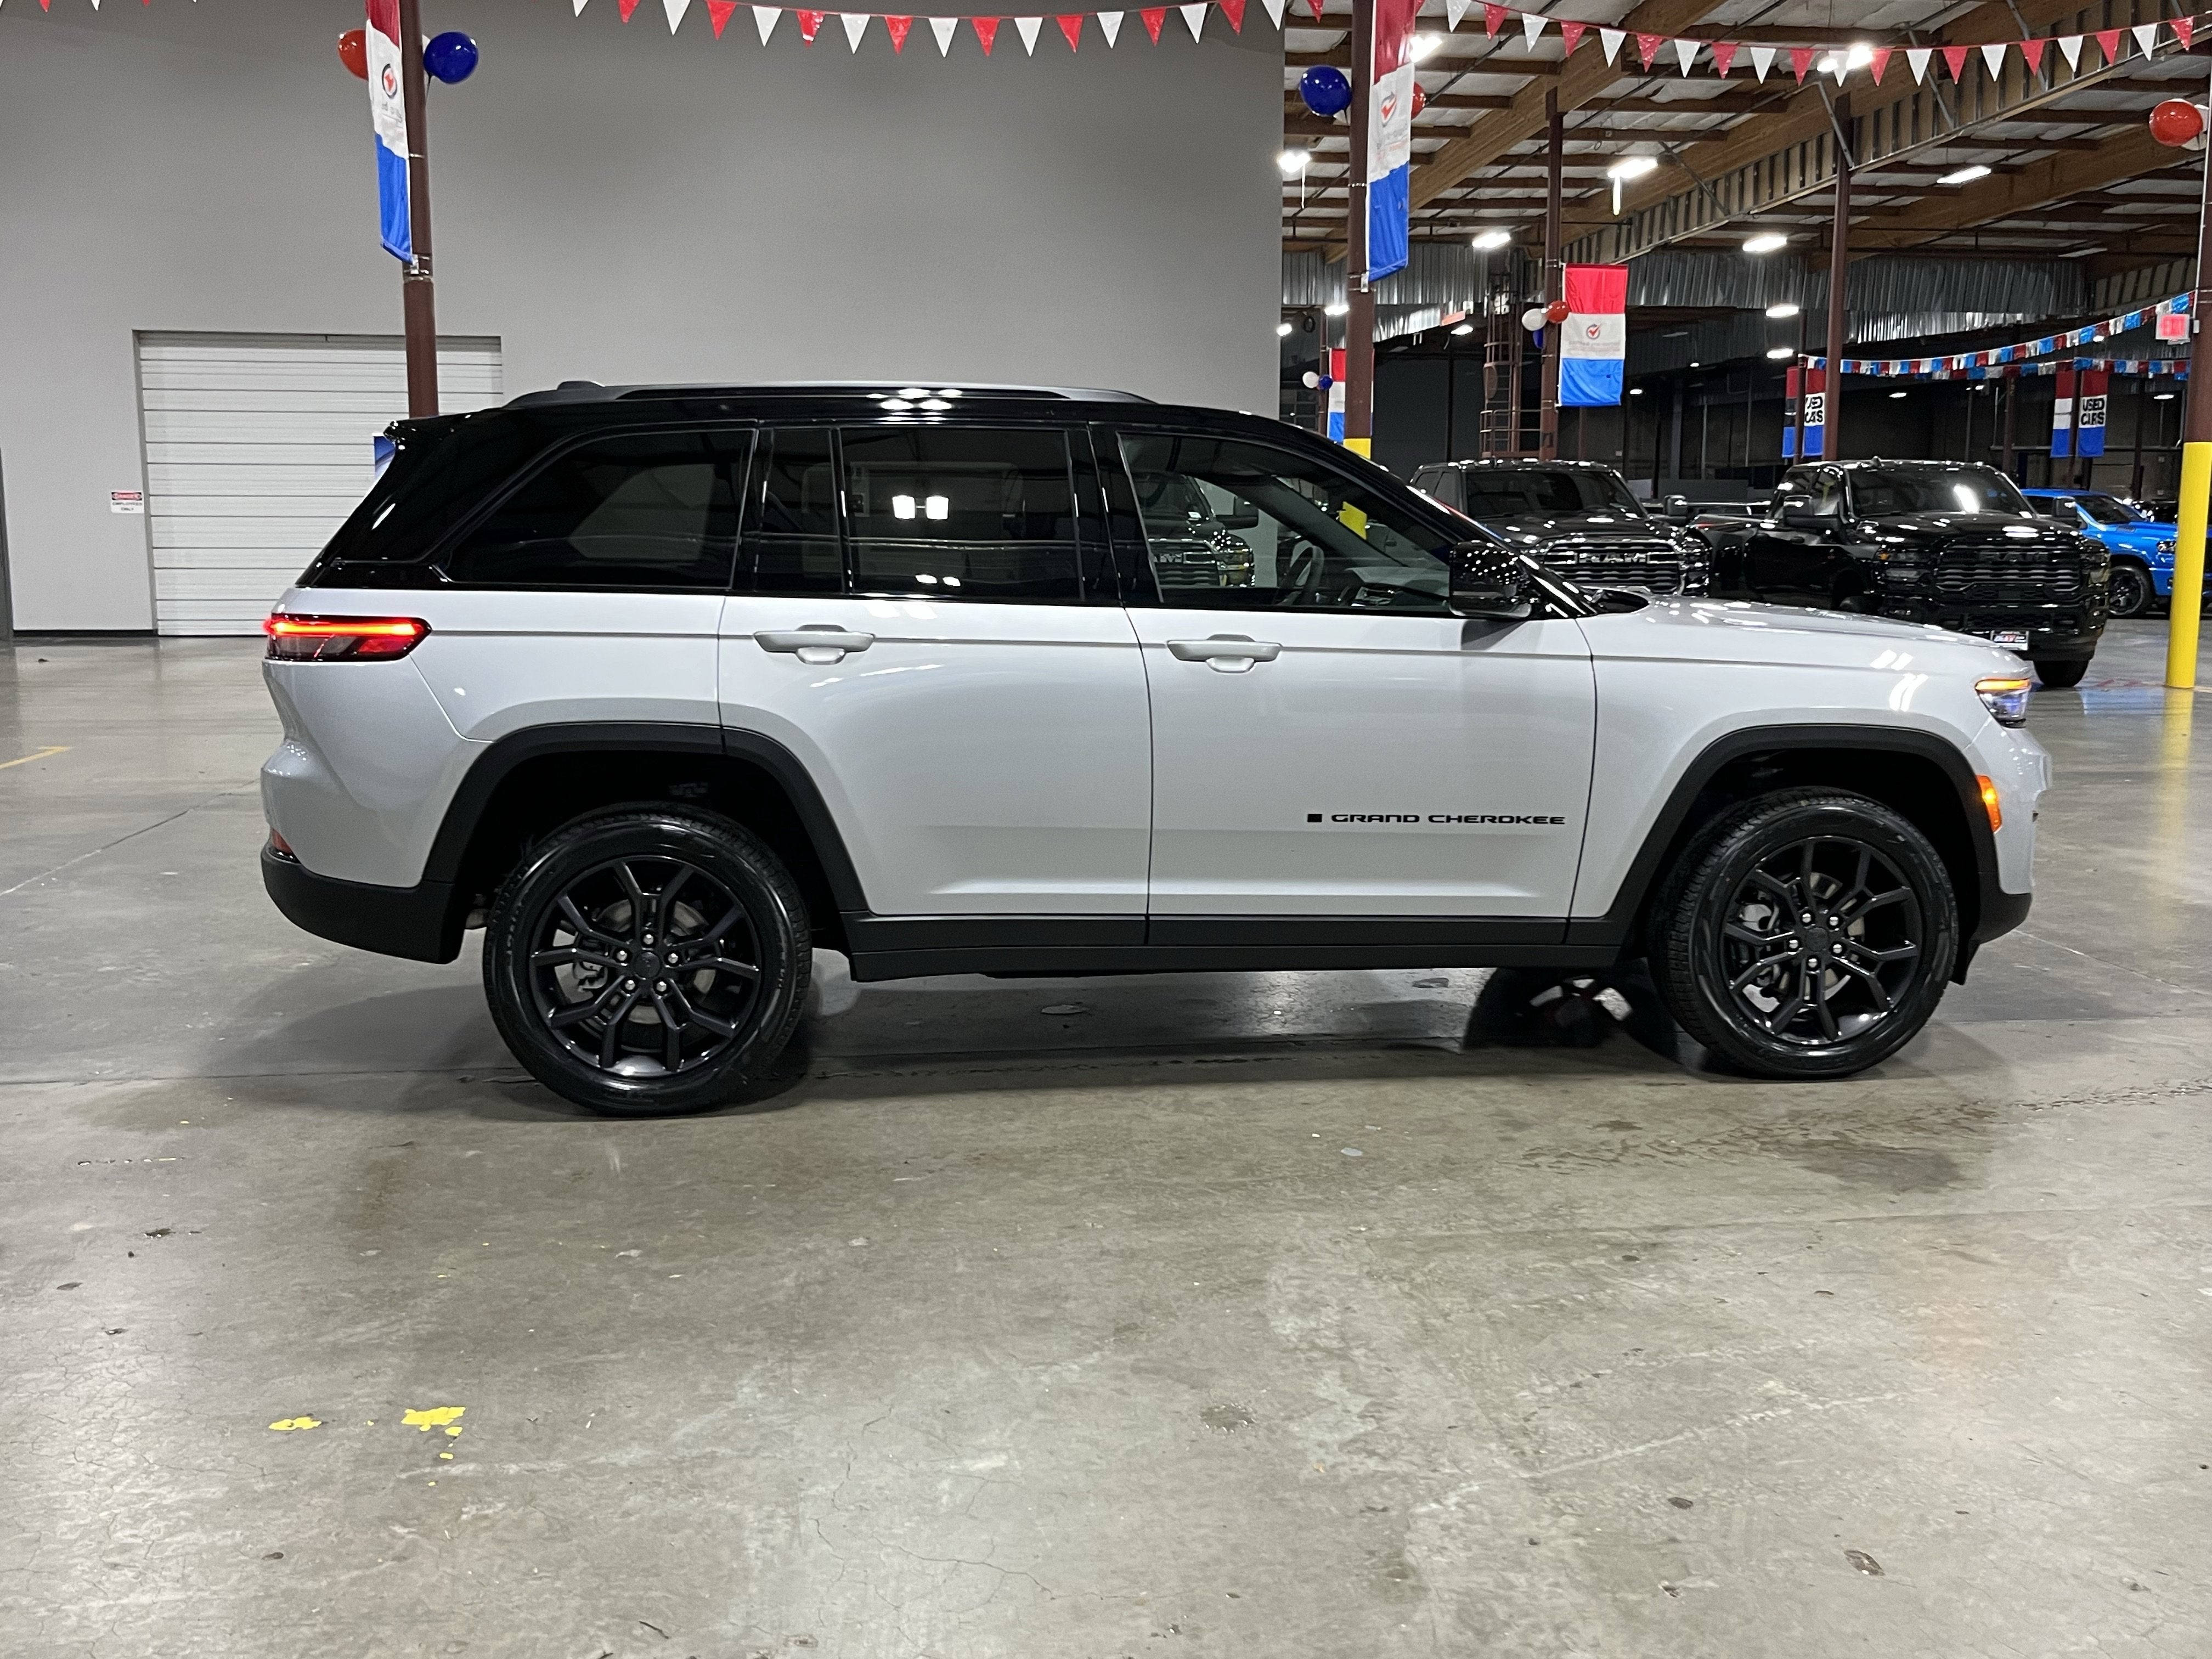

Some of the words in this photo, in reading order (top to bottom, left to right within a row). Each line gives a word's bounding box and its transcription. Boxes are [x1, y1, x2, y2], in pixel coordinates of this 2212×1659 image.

[2083, 398, 2104, 411] USED
[1331, 814, 1420, 822] GRAND
[1427, 815, 1566, 824] CHEROKEE
